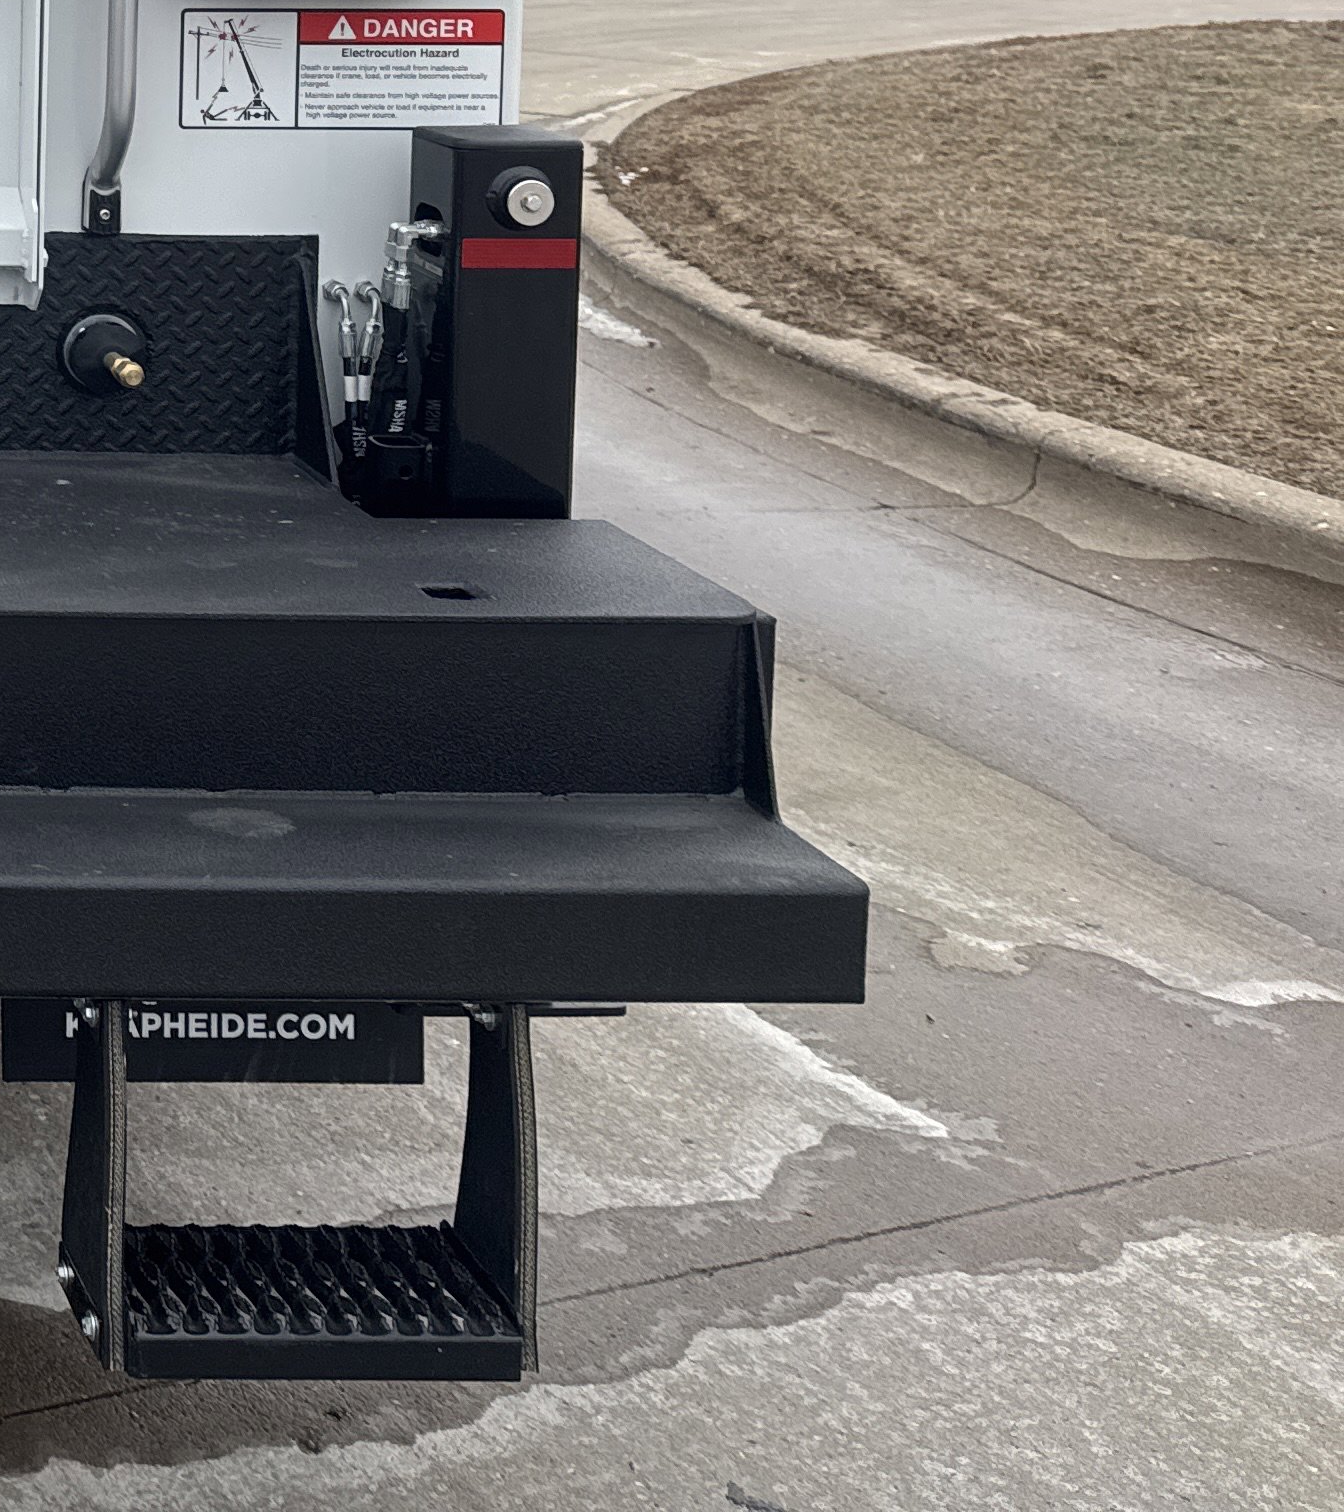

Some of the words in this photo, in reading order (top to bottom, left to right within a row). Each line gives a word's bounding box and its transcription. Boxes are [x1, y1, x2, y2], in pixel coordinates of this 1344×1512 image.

[363, 18, 474, 38] DANGER
[341, 48, 416, 58] Electrocution
[420, 48, 460, 58] Hazard
[388, 399, 408, 433] MSHA
[65, 1012, 356, 1040] KPHEIDE.COM
